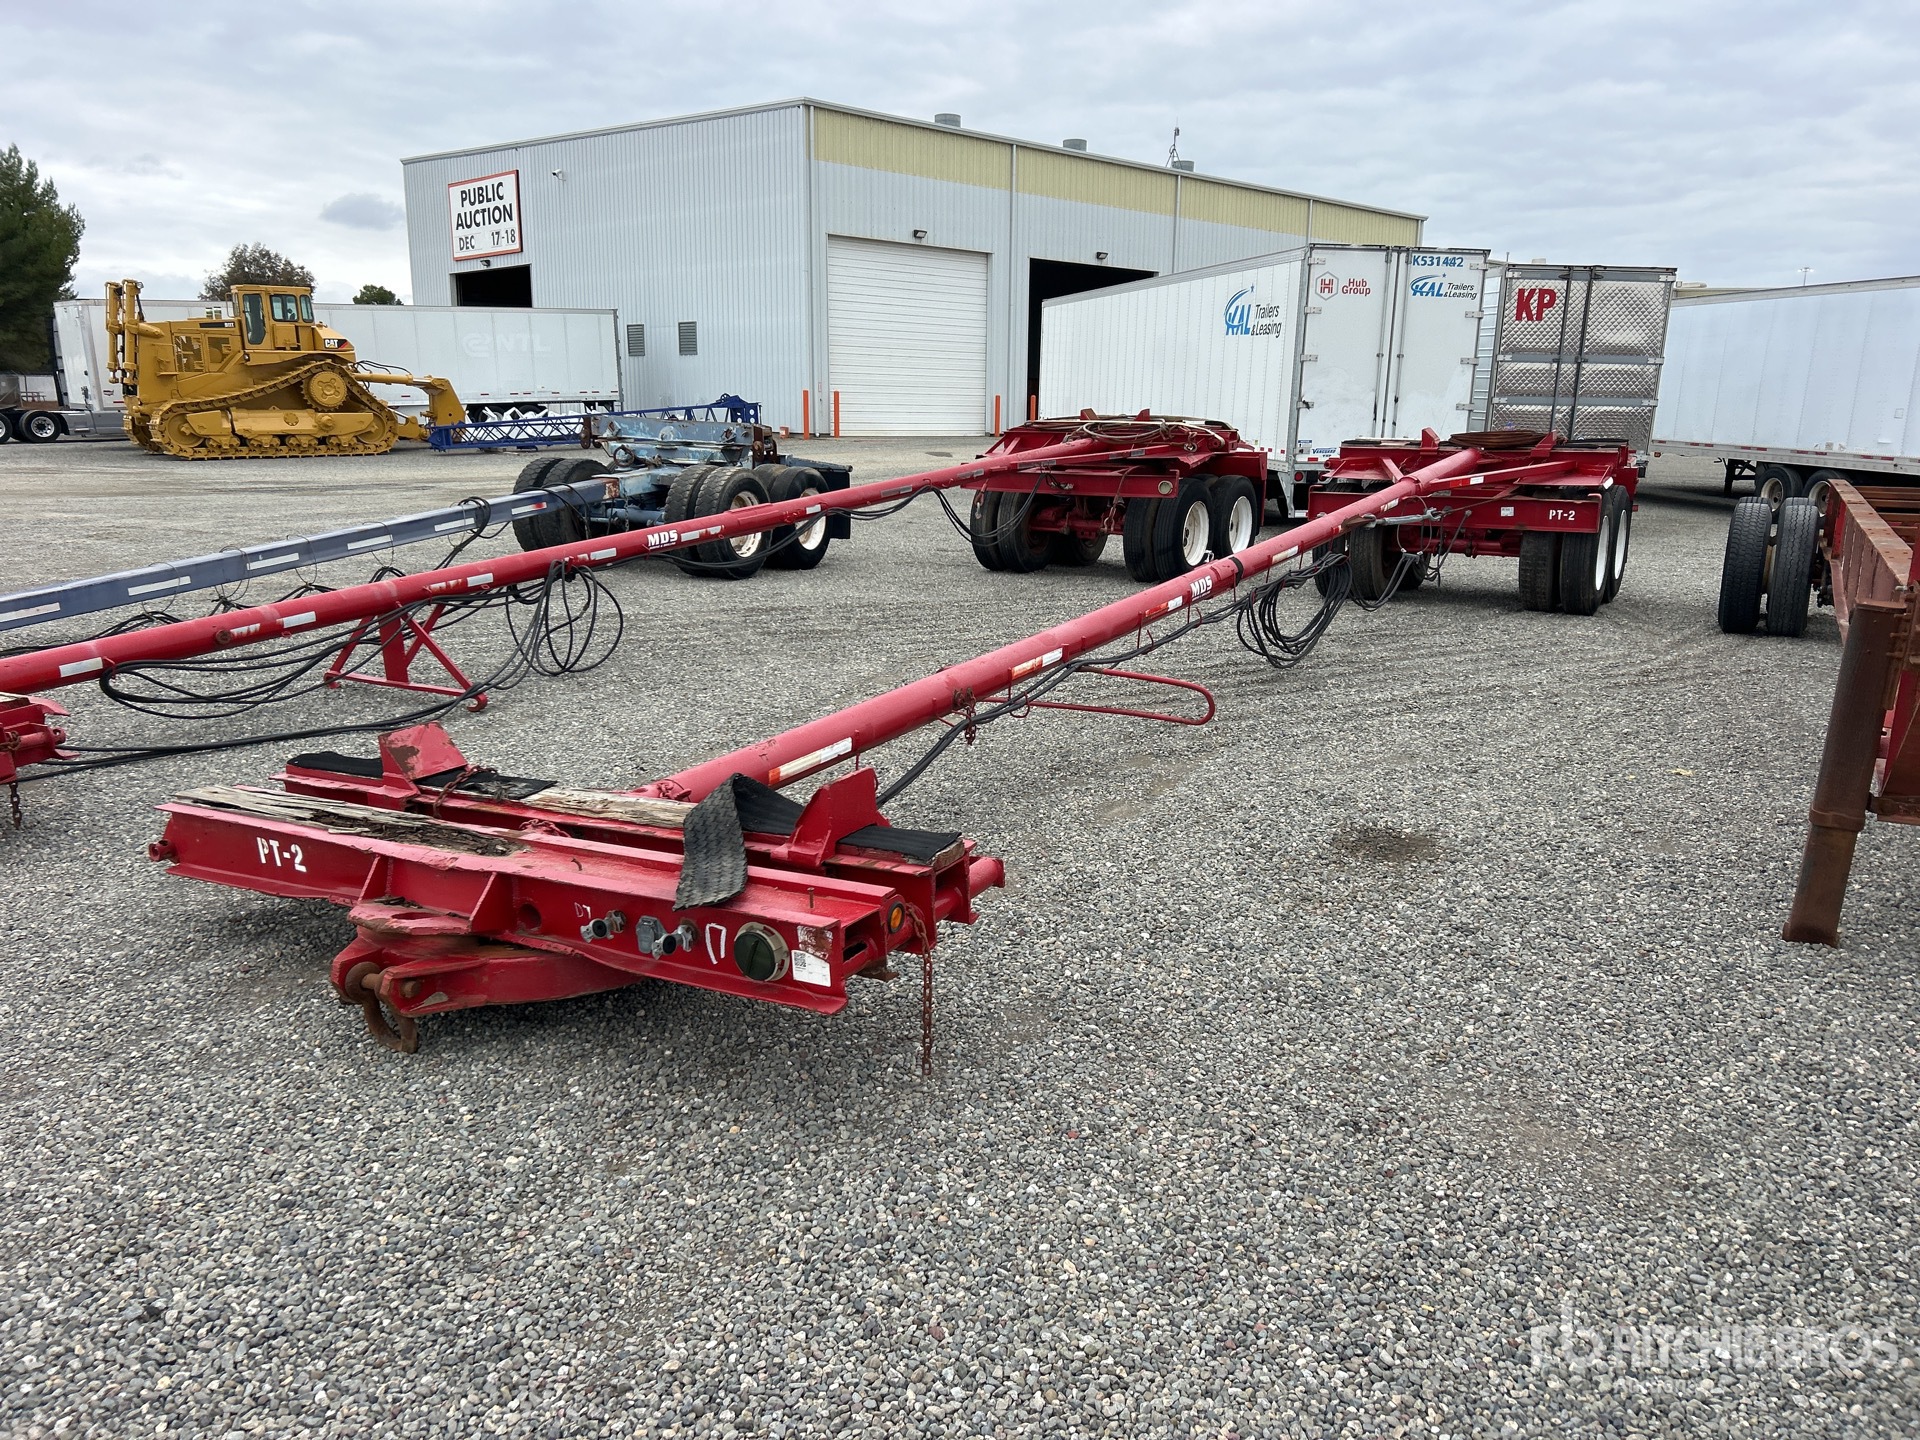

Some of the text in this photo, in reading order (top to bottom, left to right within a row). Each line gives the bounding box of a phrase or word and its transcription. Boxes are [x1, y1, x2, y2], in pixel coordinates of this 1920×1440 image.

[460, 182, 504, 207] PUBLIC
[456, 203, 513, 230] AUCTION
[459, 228, 516, 251] DEC 17-18
[1342, 285, 1371, 296] Group
[1348, 278, 1368, 287] Hub
[1411, 281, 1443, 297] KAL
[1447, 282, 1475, 290] Trailers
[1255, 303, 1279, 319] Trailers
[1515, 288, 1557, 321] KP
[1225, 303, 1251, 335] KAL
[325, 339, 338, 348] CAT
[1549, 509, 1576, 520] PT-2
[647, 529, 678, 546] MDS
[1190, 575, 1213, 598] MDS
[256, 836, 307, 873] PT-2
